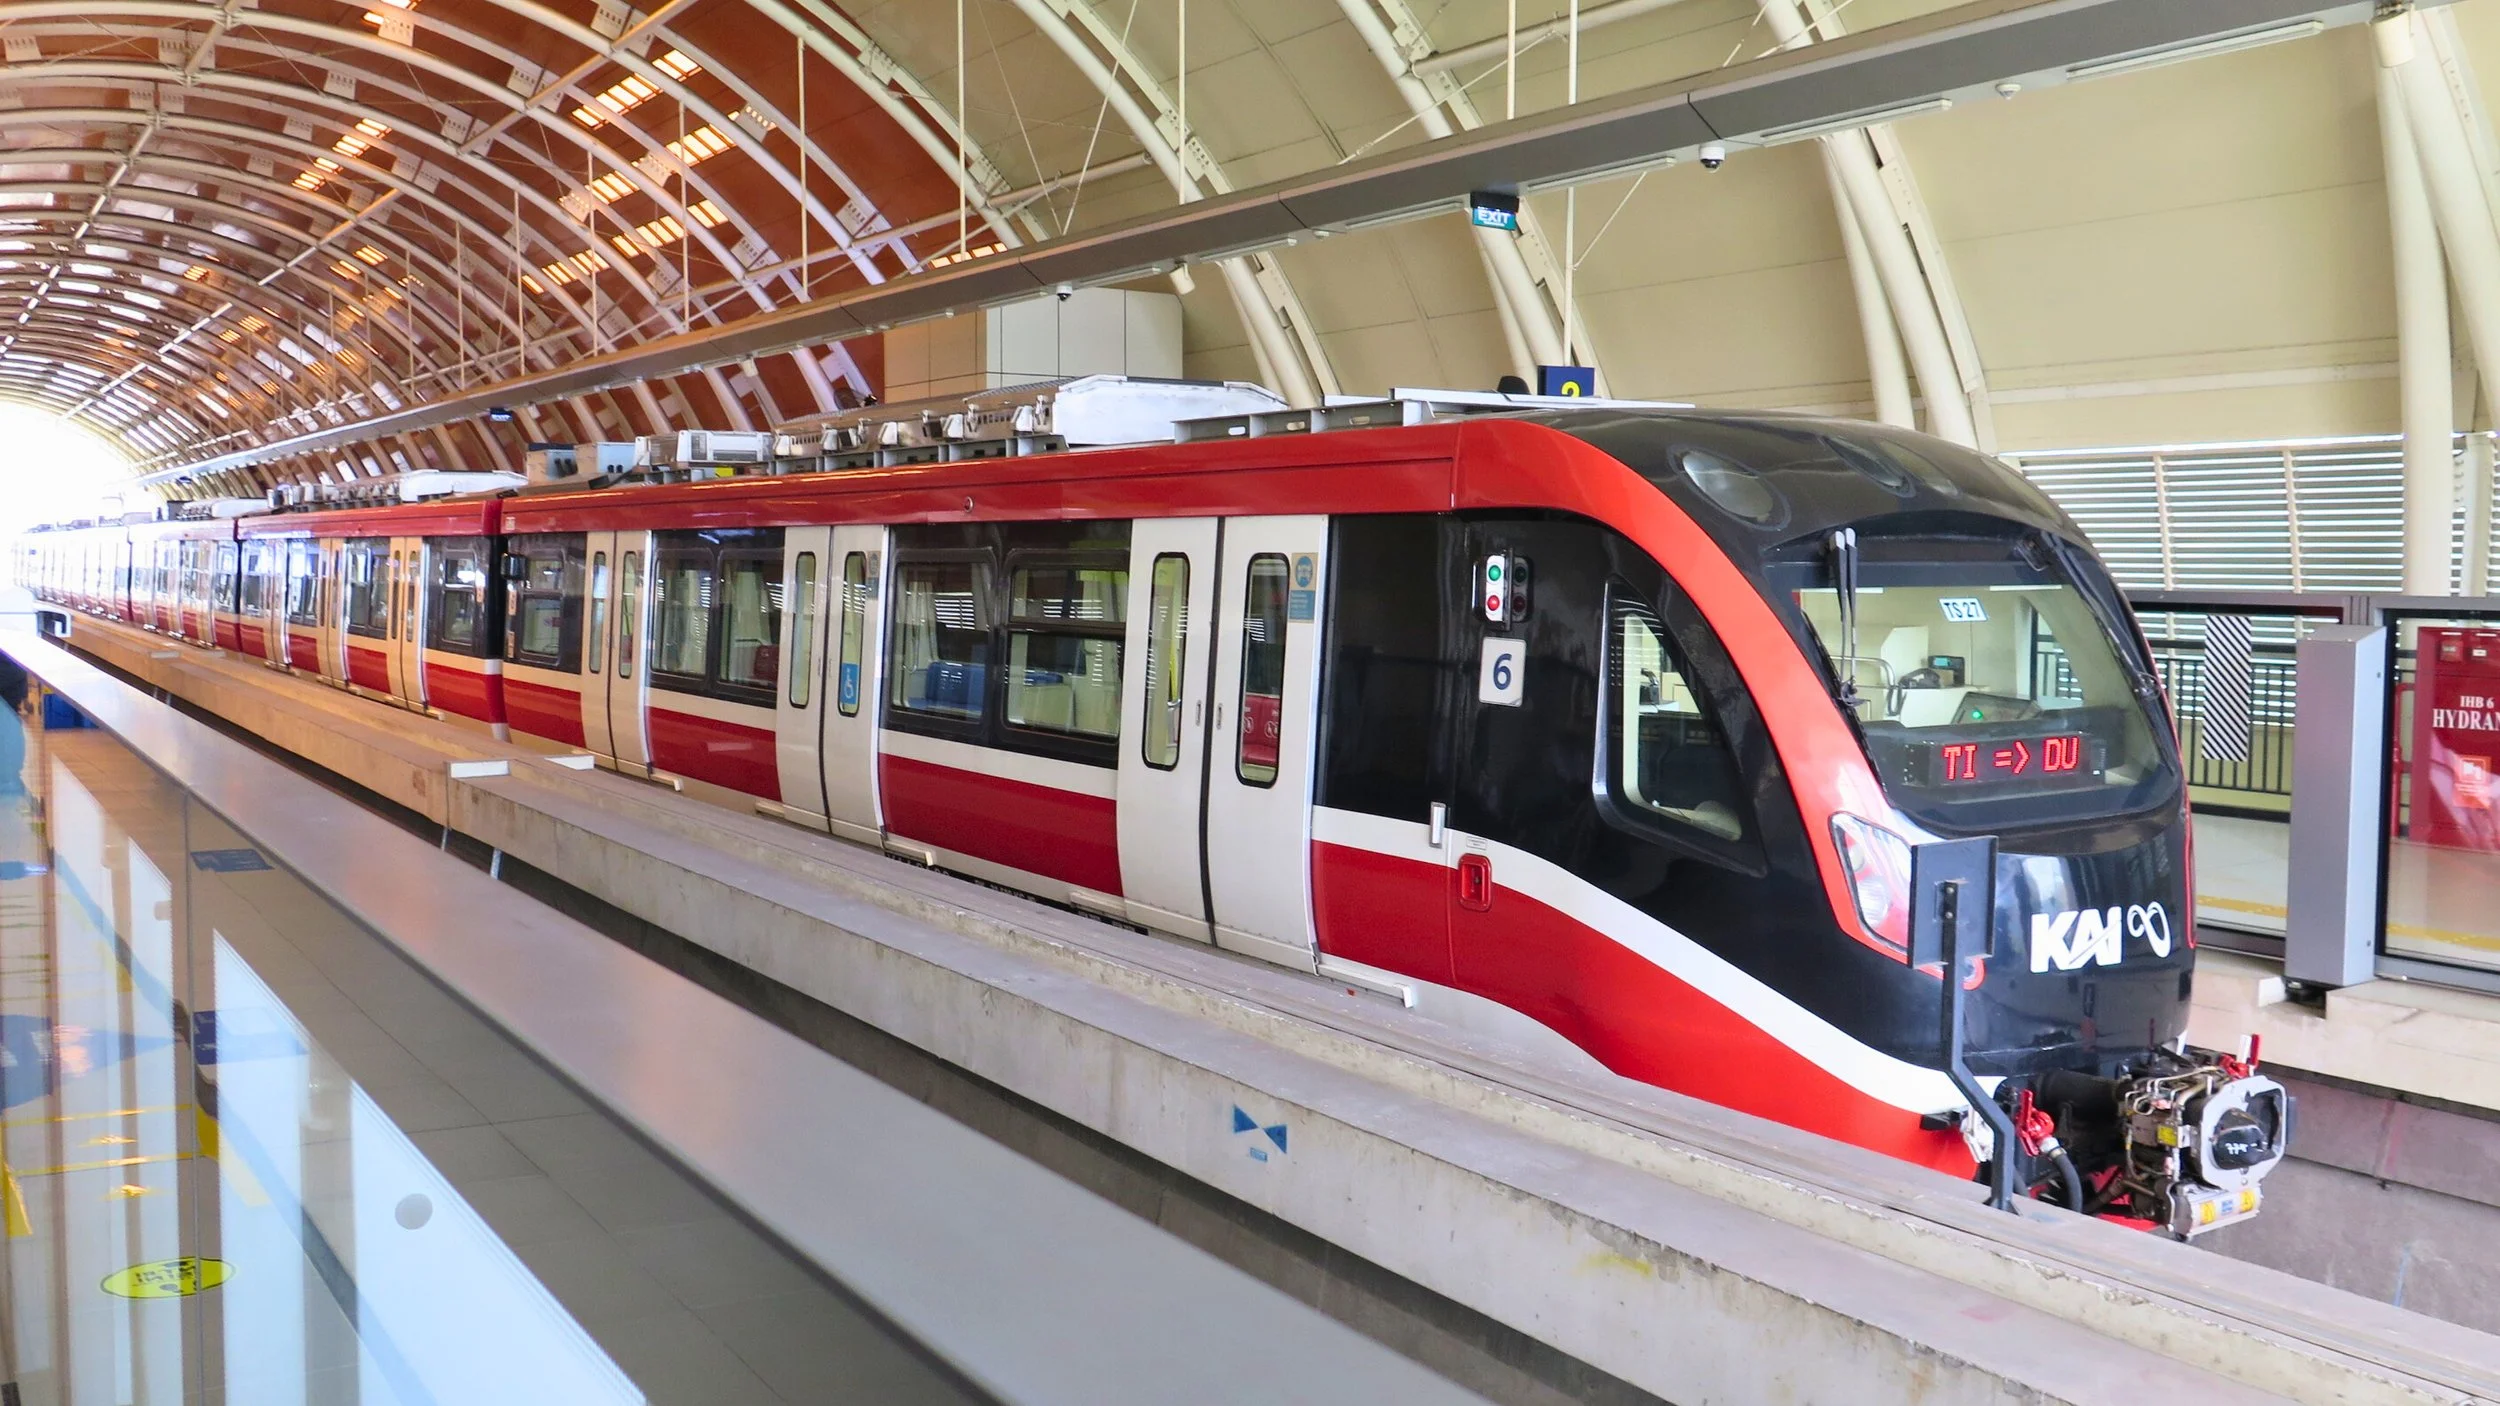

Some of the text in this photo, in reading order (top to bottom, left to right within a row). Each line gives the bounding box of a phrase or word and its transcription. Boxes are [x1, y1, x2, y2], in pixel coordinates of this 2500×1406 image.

[1478, 209, 1511, 224] EXIT
[1561, 381, 1580, 397] 2
[1493, 653, 1512, 690] 6
[2460, 695, 2495, 709] IHB 6
[1943, 744, 1977, 780] TI
[2043, 736, 2079, 771] DU
[2030, 905, 2122, 973] KAI
